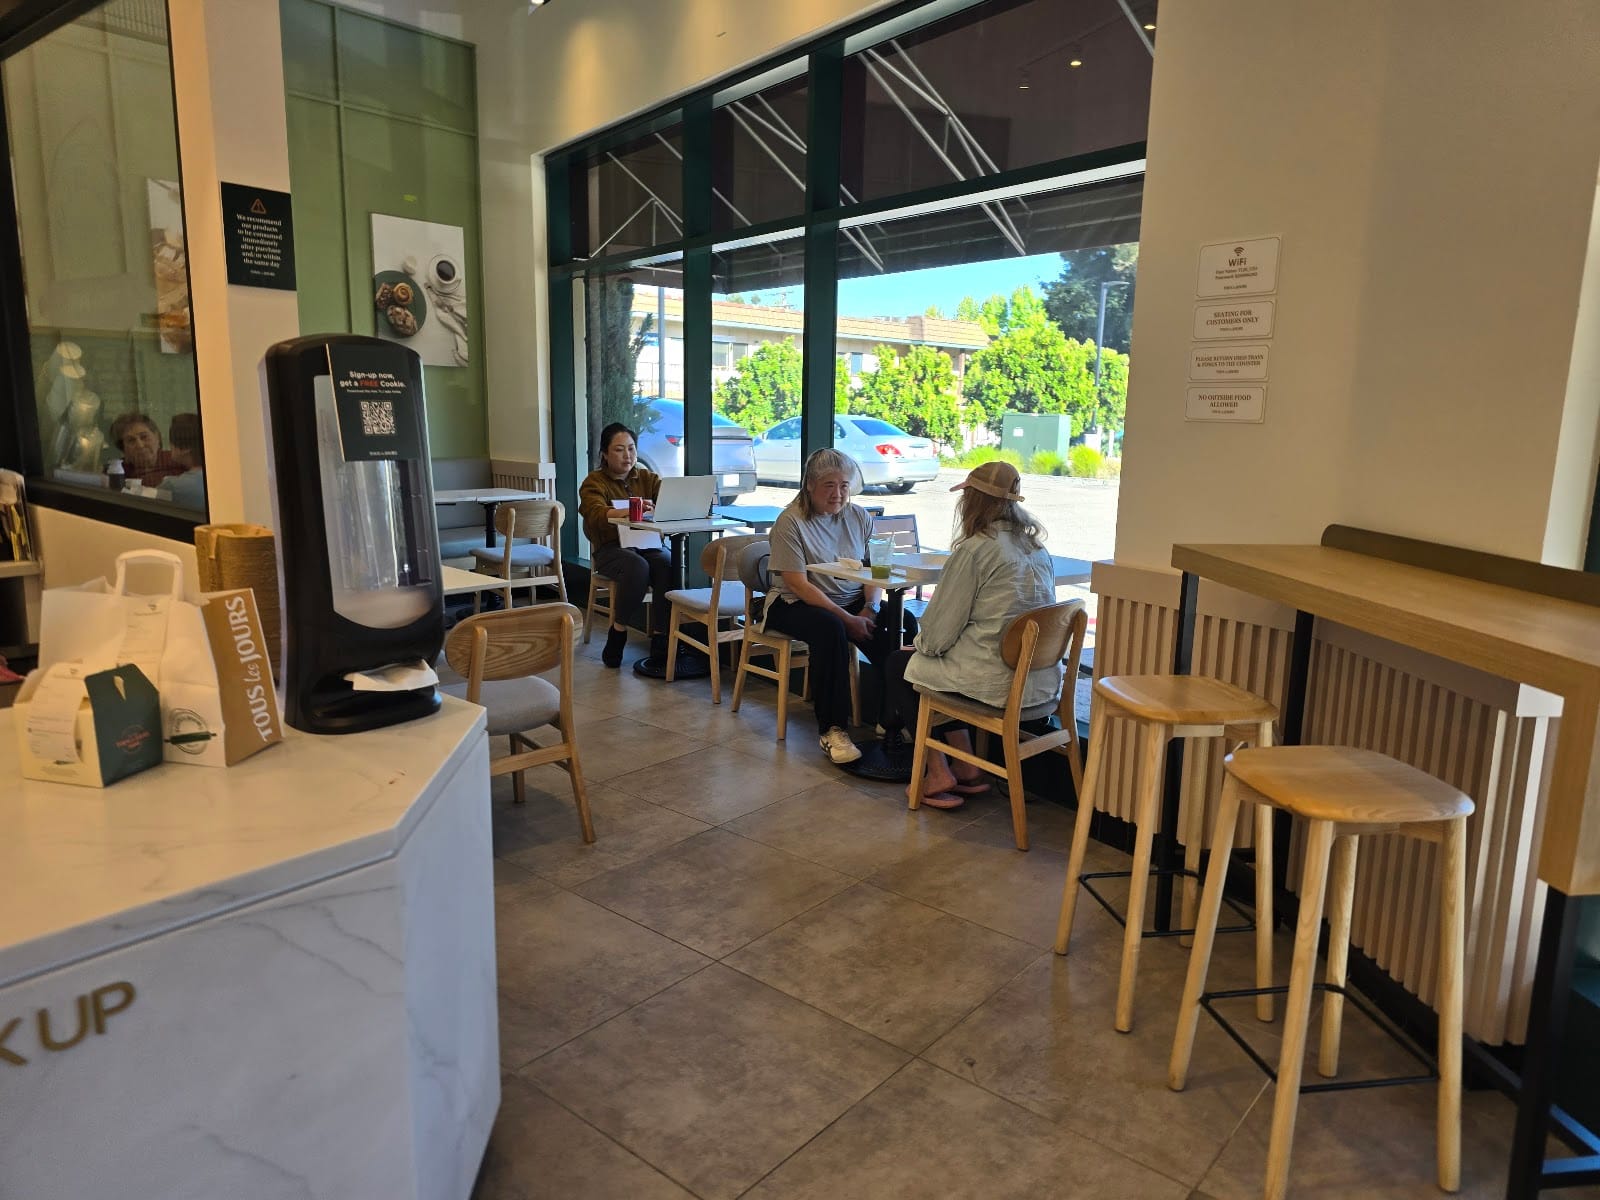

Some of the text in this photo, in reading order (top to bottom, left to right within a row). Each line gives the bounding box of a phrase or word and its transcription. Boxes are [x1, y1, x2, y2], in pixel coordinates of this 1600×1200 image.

[247, 217, 282, 226] recommend
[252, 223, 278, 233] products
[253, 231, 282, 240] consumed
[242, 236, 278, 247] immediately
[255, 245, 281, 254] purchase
[1228, 258, 1247, 266] WiFi
[1213, 310, 1239, 318] SEATING
[1242, 316, 1259, 324] ONLY
[349, 370, 395, 380] Sign-up now,
[339, 379, 352, 387] get
[225, 596, 263, 664] JOURS
[246, 684, 273, 742] TOUS
